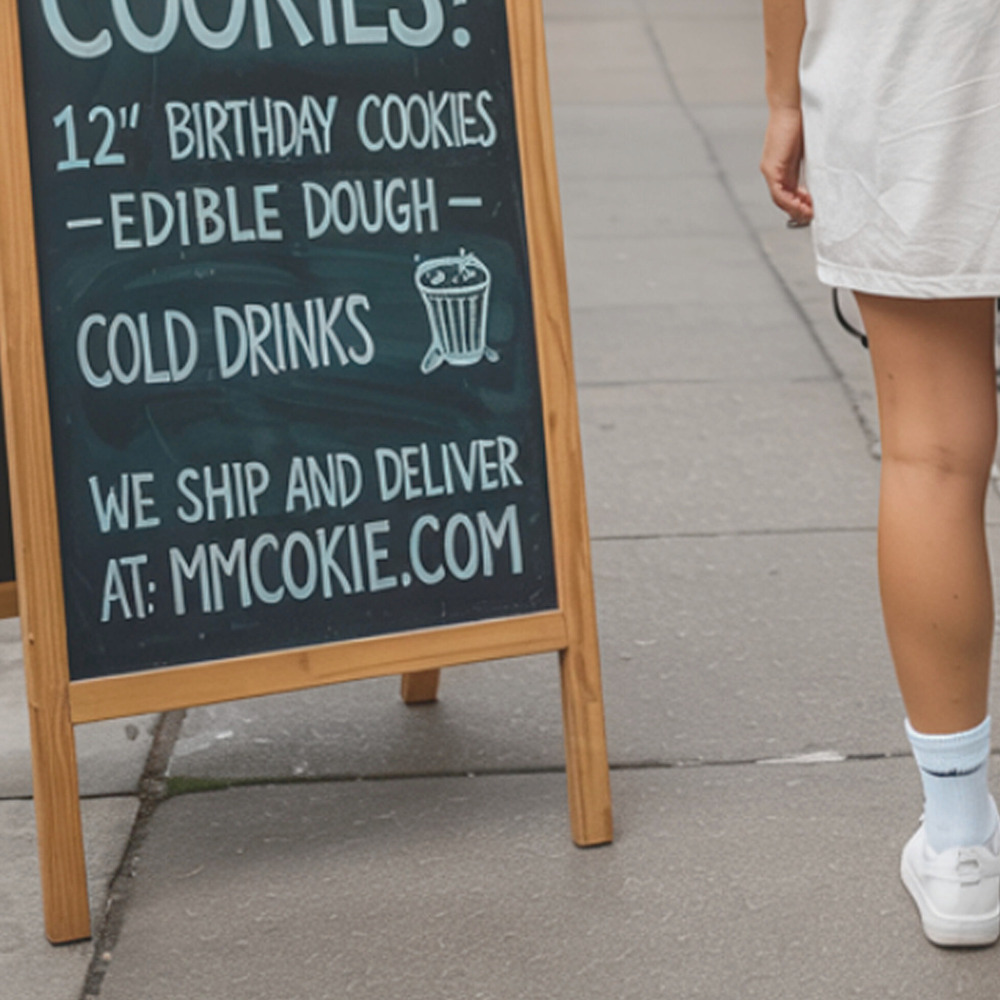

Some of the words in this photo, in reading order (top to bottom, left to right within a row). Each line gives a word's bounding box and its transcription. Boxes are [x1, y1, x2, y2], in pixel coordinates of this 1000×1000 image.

[53, 102, 140, 171] 12"
[164, 95, 338, 161] BIRTHDAY
[357, 90, 497, 152] COOKIES
[301, 177, 439, 239] DOUGH
[77, 310, 198, 388] COLD
[213, 293, 375, 379] DRINKS
[88, 472, 161, 533] WE
[177, 461, 270, 523] SHIP
[285, 452, 362, 512] AND
[375, 435, 523, 502] DELIVER
[101, 554, 156, 622] AT:
[169, 504, 524, 615] MMCOKIE.COM
